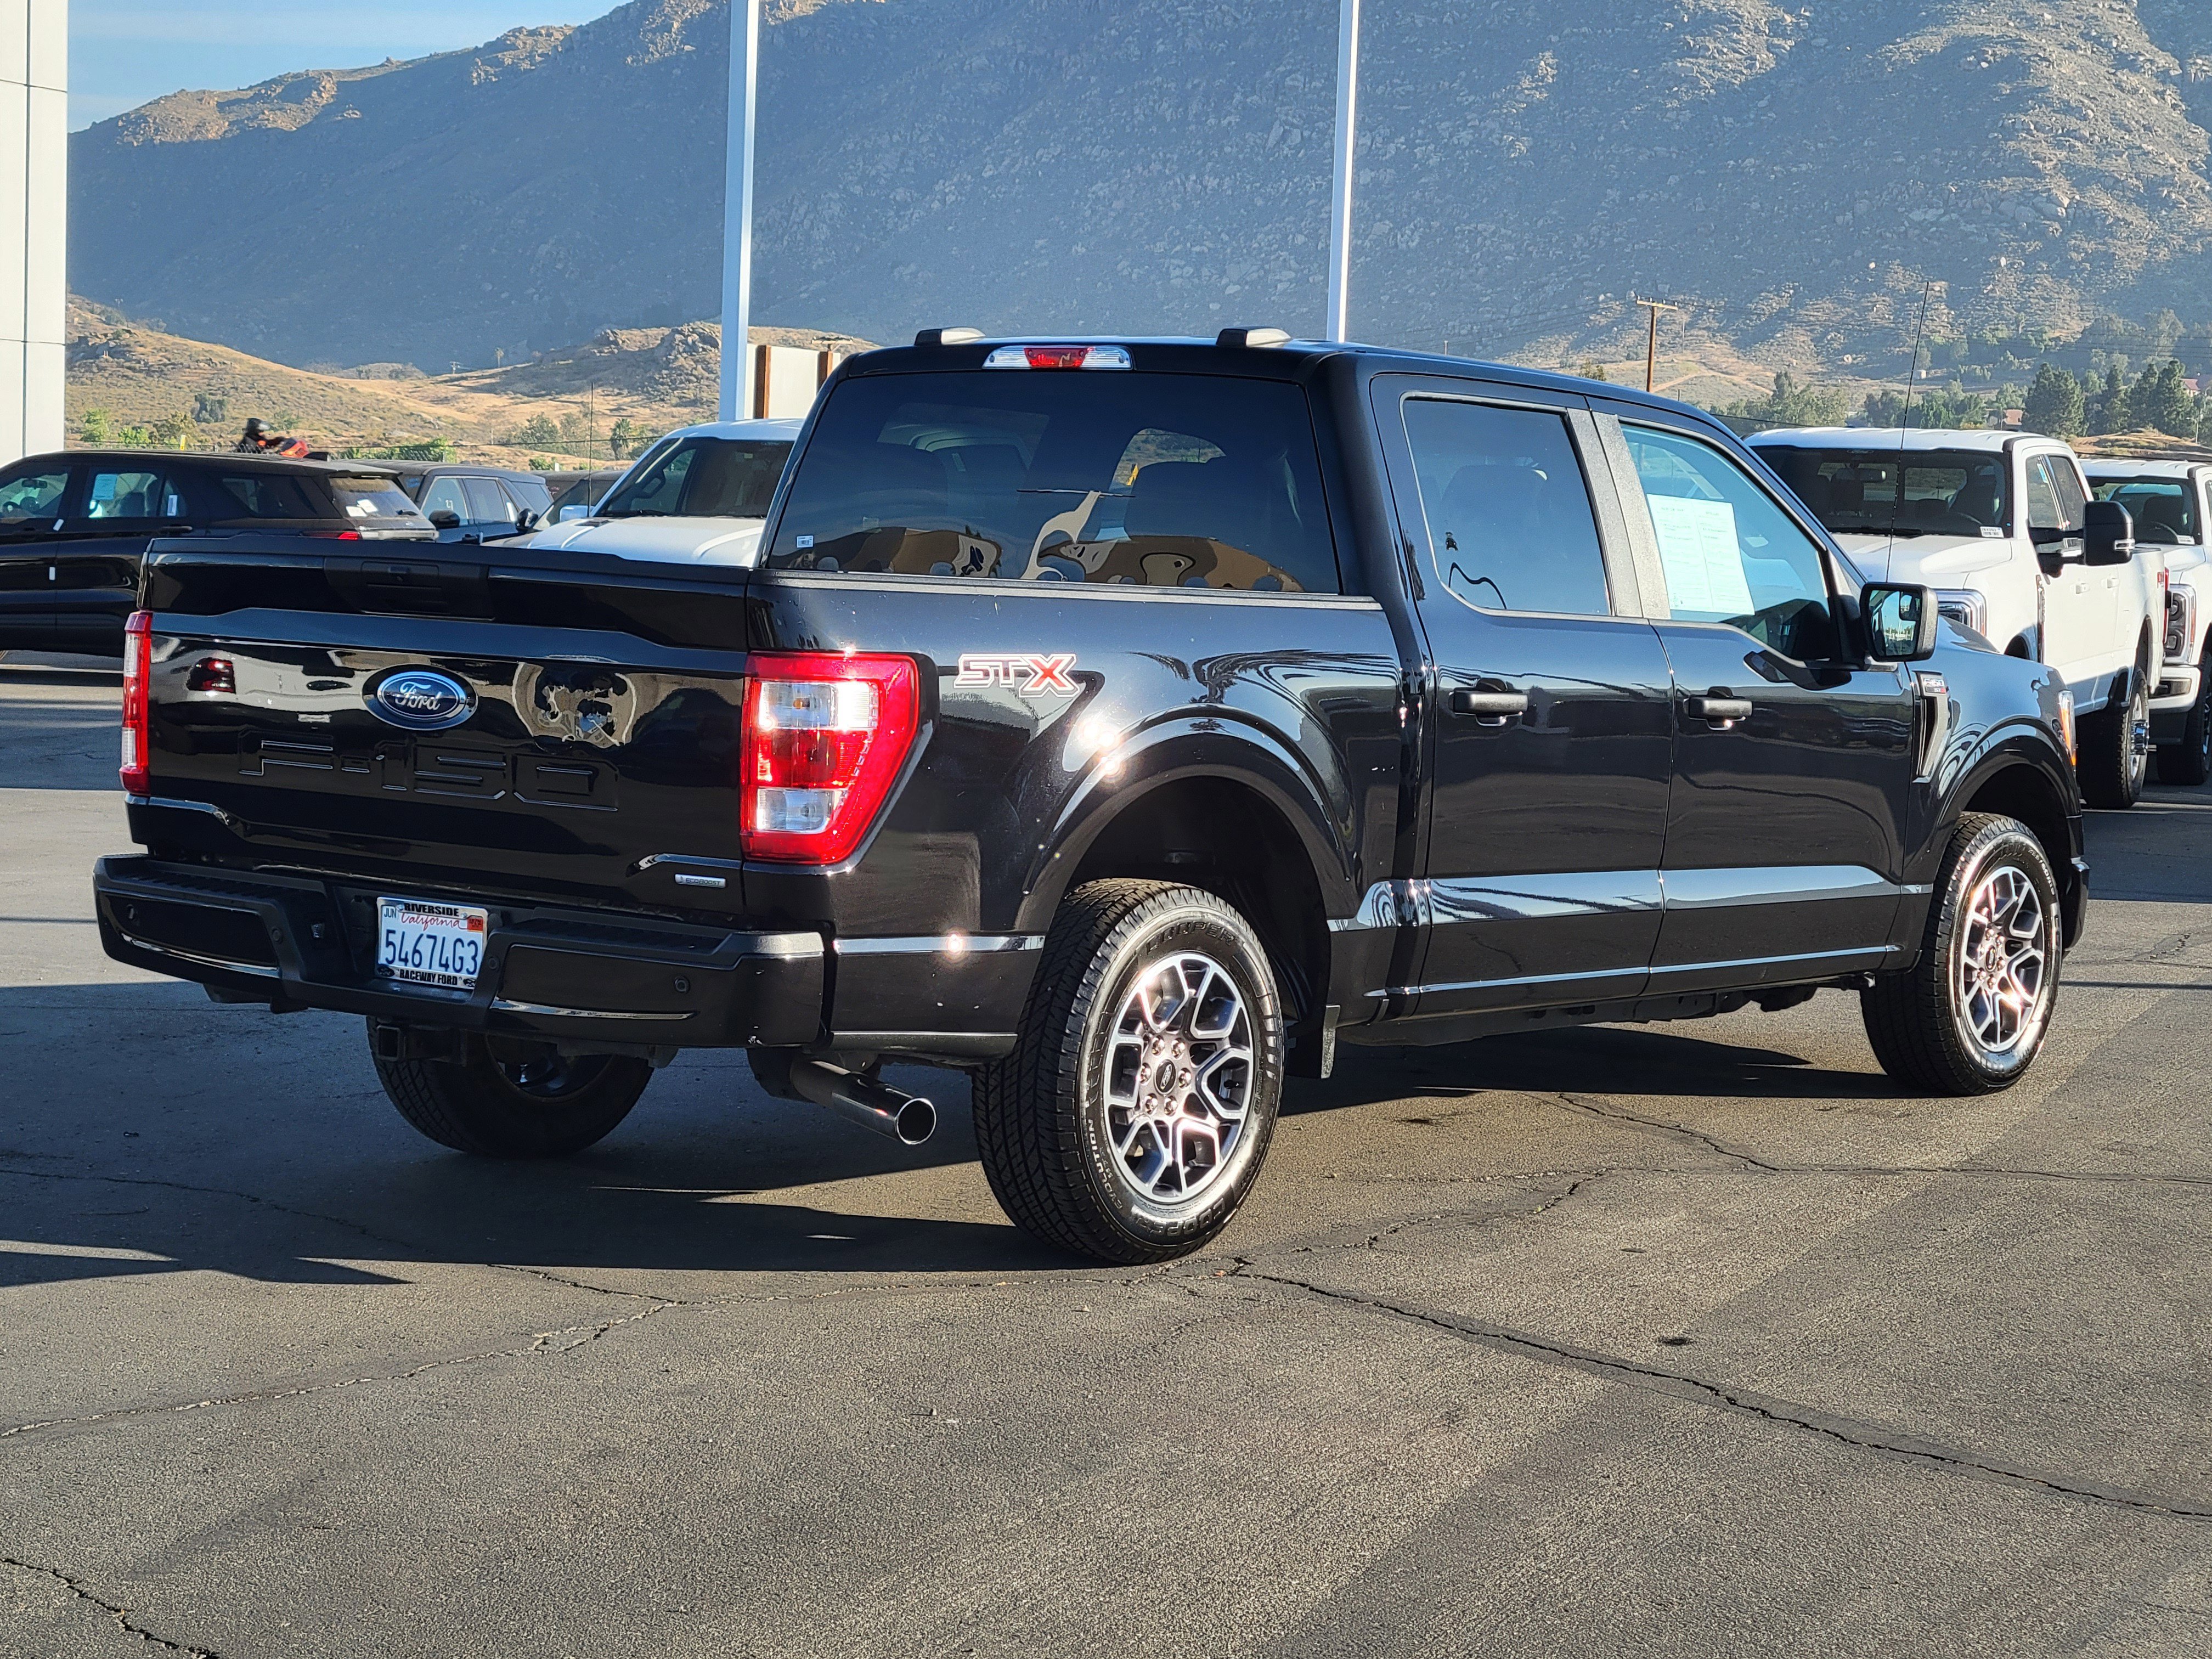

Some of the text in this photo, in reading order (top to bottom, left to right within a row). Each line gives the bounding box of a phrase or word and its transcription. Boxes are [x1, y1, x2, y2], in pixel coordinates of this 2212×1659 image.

[953, 653, 1080, 697] STX
[396, 680, 441, 712] Ford
[384, 908, 397, 918] JUN
[401, 913, 467, 931] California
[403, 902, 459, 917] RIVERSIDE
[385, 929, 478, 975] 54674G3
[1147, 921, 1235, 955] COOPER
[399, 969, 458, 986] RACEWAY FORD
[1088, 1119, 1123, 1209] EVOLUTION
